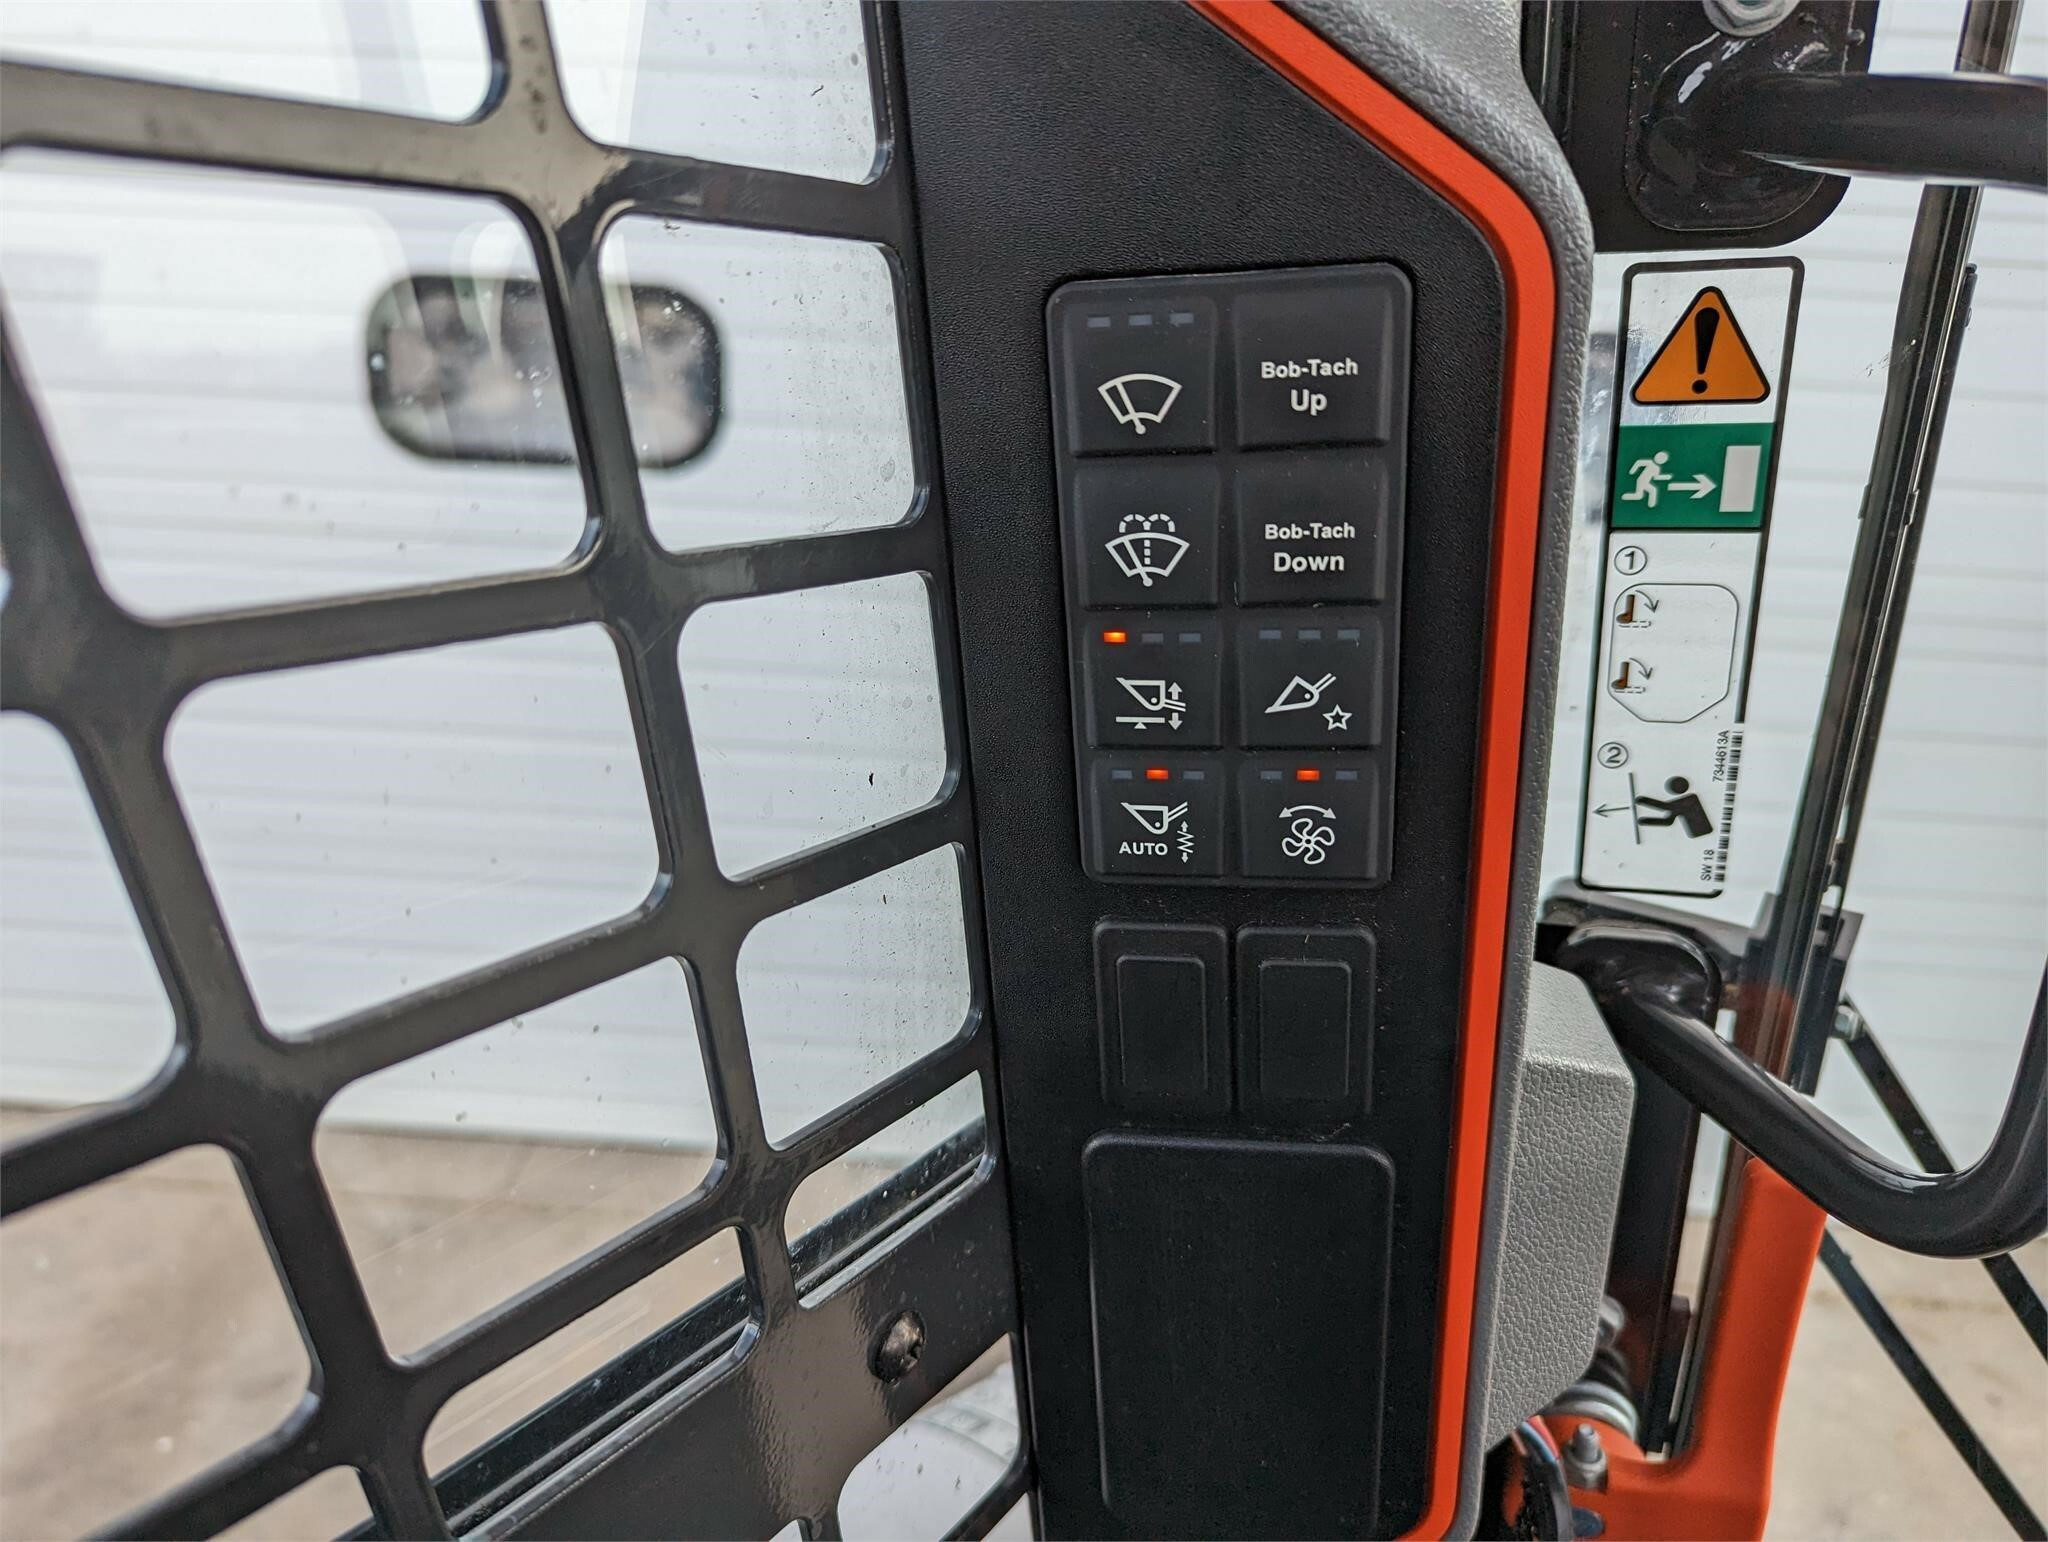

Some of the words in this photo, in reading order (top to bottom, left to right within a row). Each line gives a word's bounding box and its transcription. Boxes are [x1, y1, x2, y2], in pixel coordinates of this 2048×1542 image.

[1260, 357, 1359, 379] Bob-Tach
[1289, 388, 1328, 416] Up
[1264, 522, 1356, 541] Bob-Tach
[1273, 551, 1346, 574] Down
[1712, 729, 1730, 782] 7344613A
[1119, 841, 1168, 856] AUTO
[1703, 848, 1715, 861] 18
[1700, 863, 1713, 881] SW
